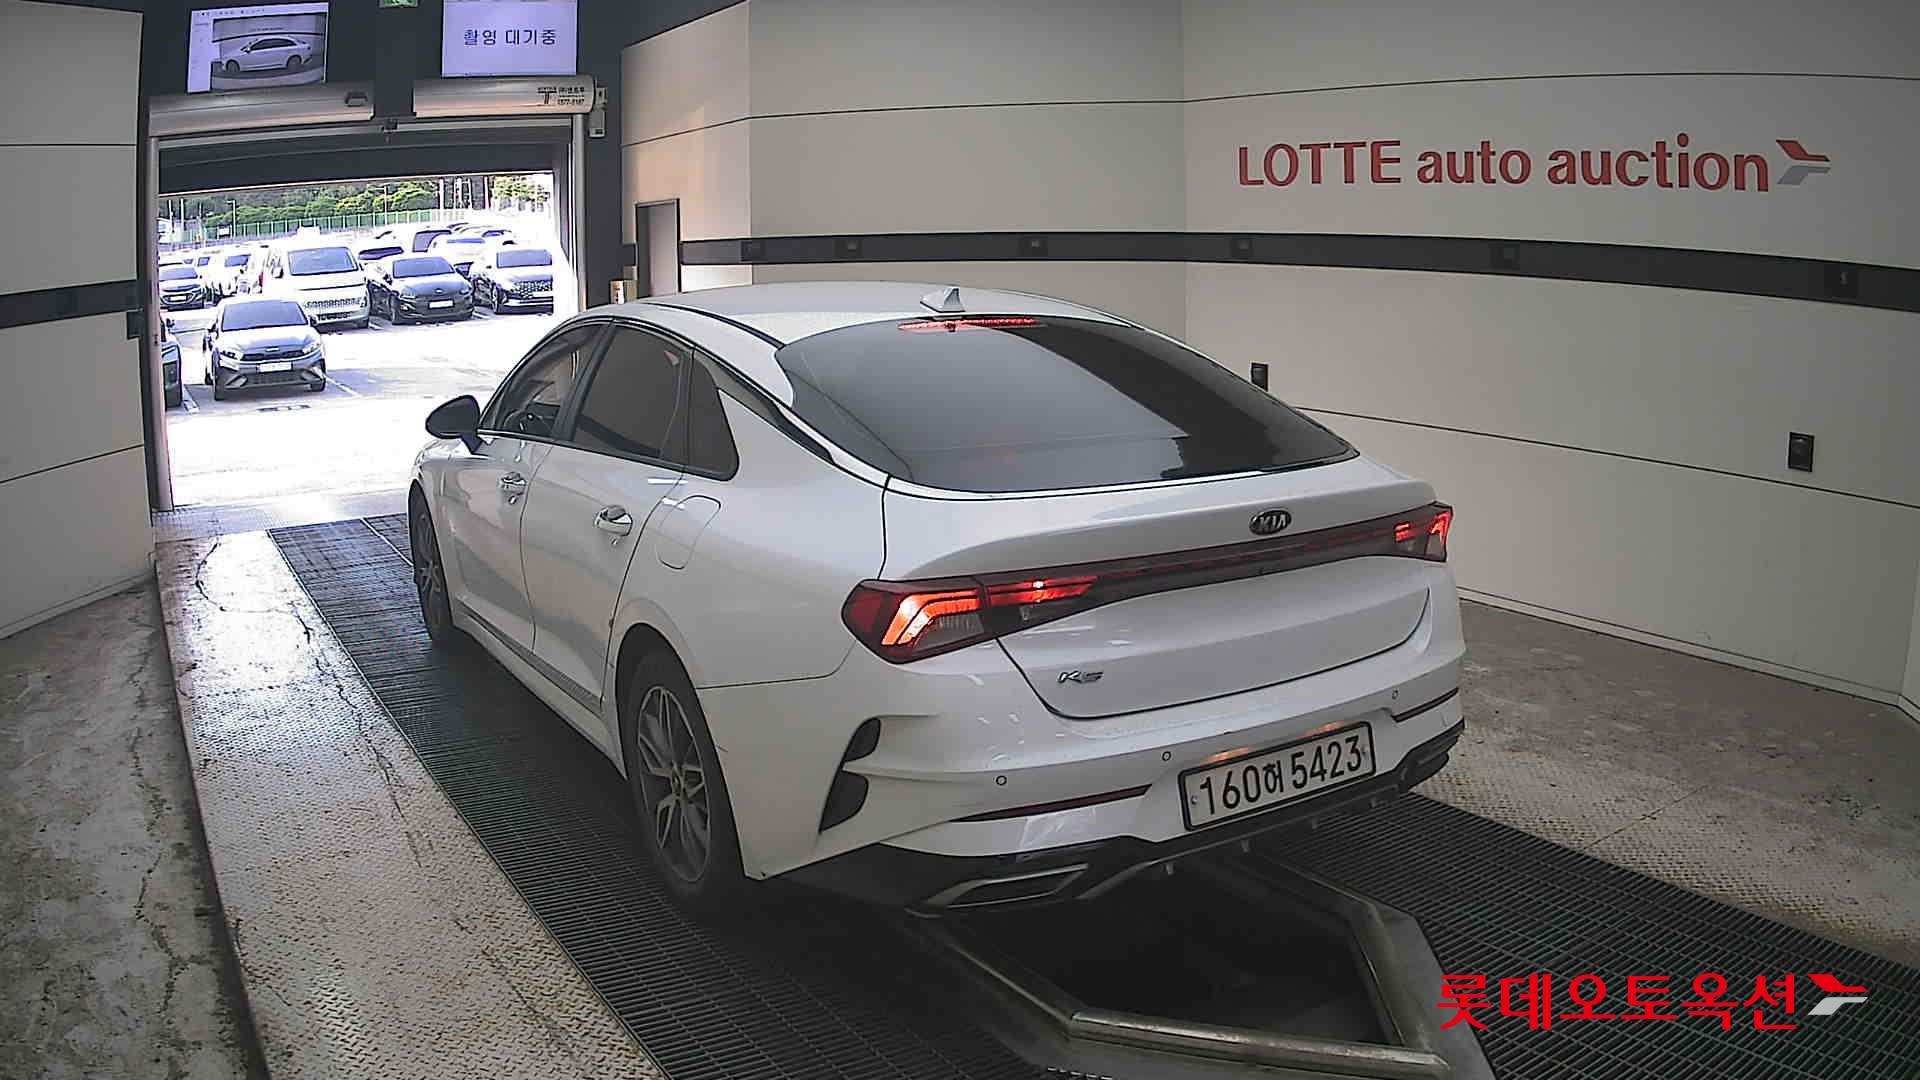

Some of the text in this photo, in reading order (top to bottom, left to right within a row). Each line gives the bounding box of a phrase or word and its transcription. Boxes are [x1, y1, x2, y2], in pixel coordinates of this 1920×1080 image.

[463, 29, 556, 46] 촬영 대기중
[1238, 133, 1769, 192] LOTTE auto auction
